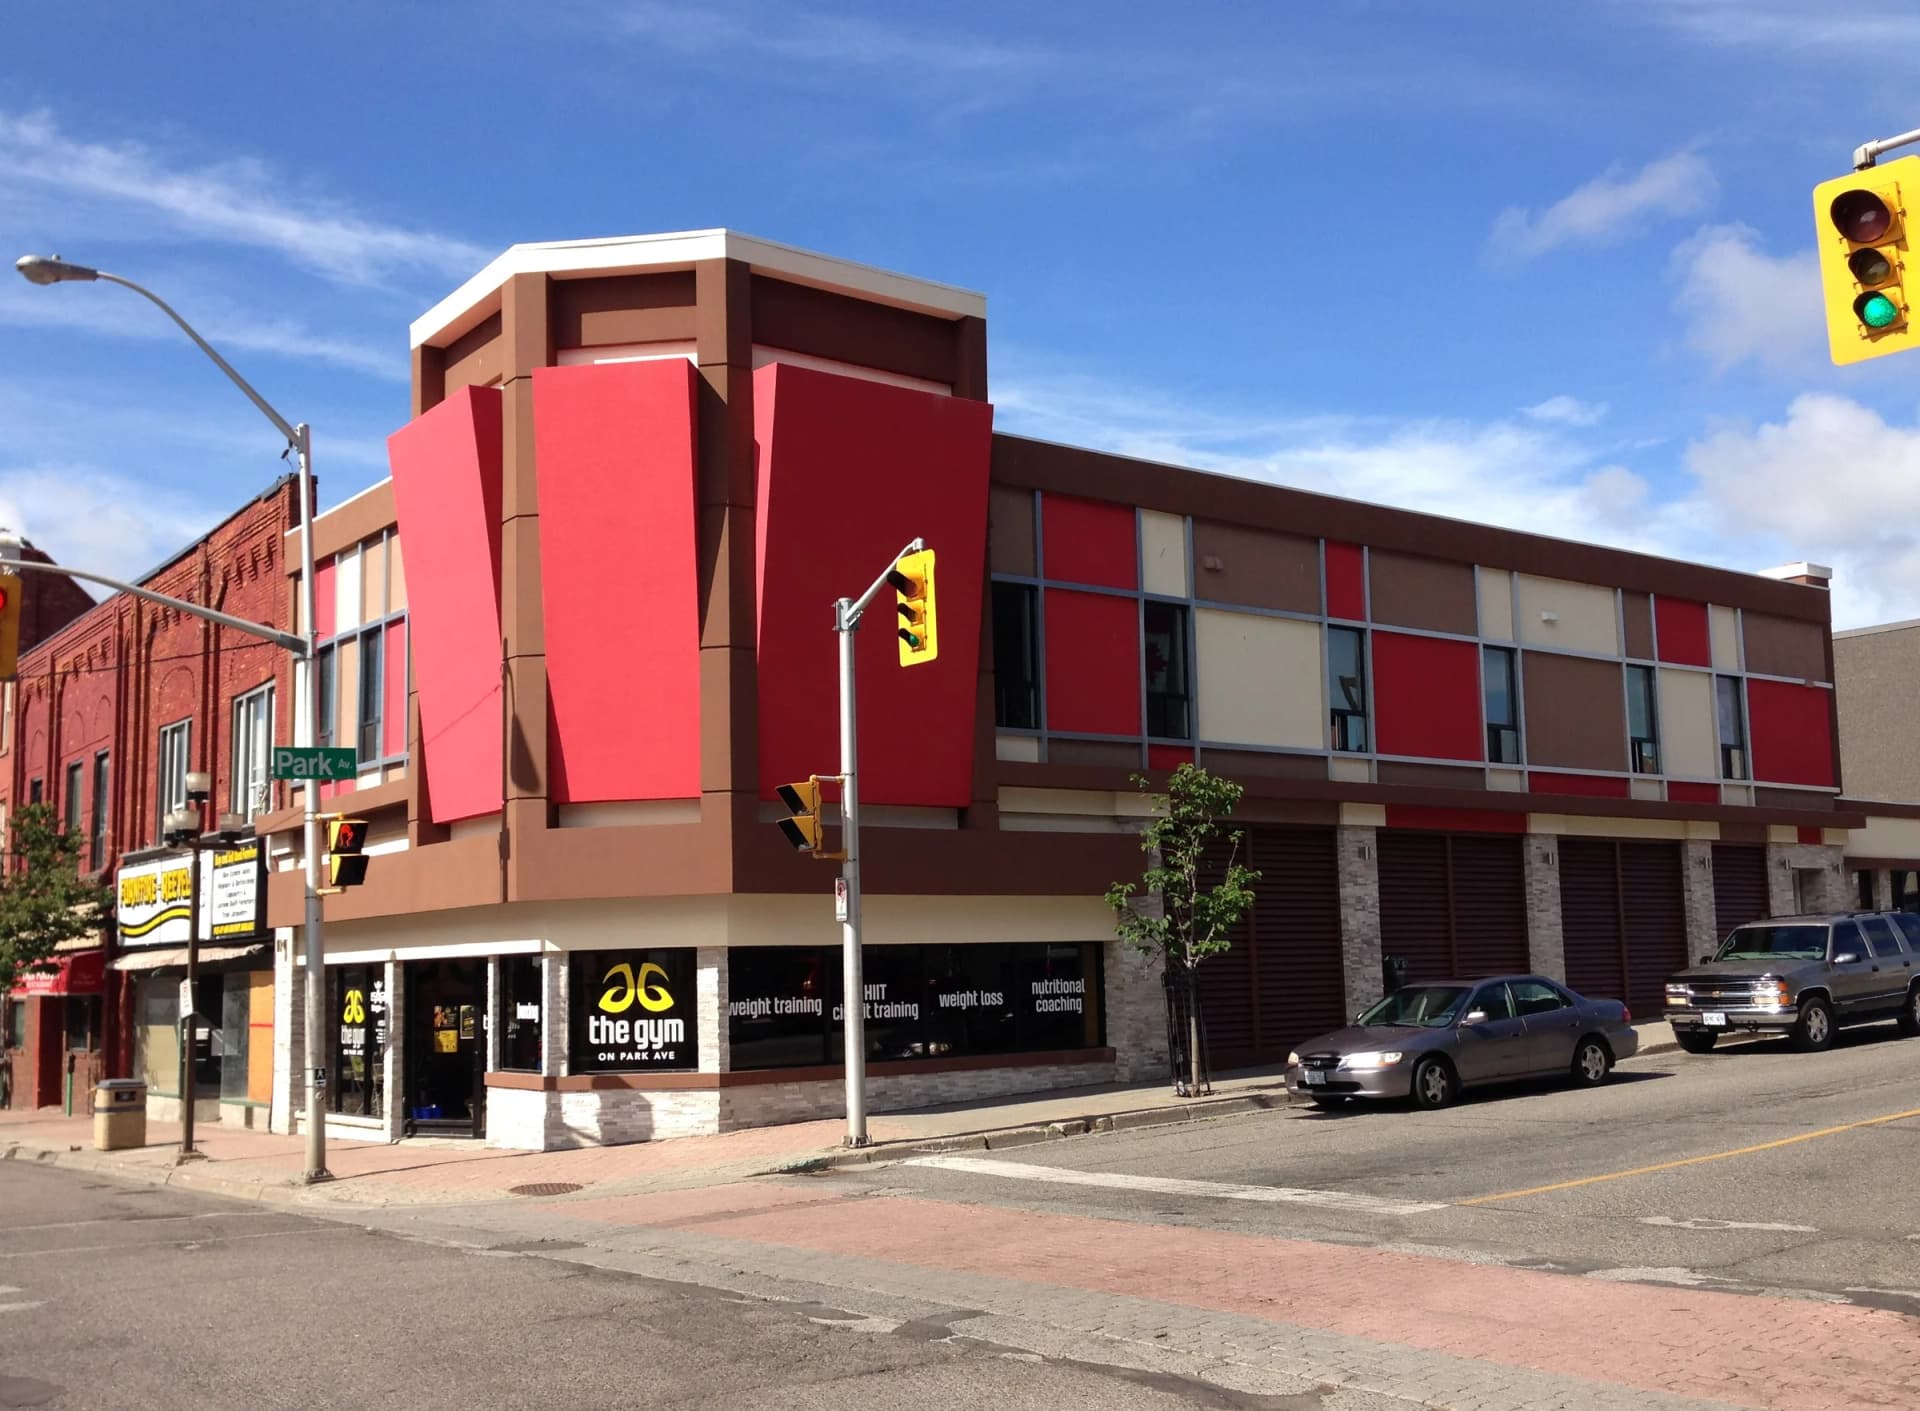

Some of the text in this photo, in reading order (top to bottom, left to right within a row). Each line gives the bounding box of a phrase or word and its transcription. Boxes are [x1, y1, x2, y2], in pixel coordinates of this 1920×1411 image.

[276, 751, 353, 776] Park Av.
[864, 984, 887, 1001] HIIT
[1031, 978, 1085, 995] nutritional
[729, 996, 822, 1019] weight training
[939, 990, 1004, 1010] weight loss
[1035, 996, 1082, 1014] coaching
[874, 1001, 919, 1020] training
[589, 1015, 684, 1050] the gym
[598, 1050, 675, 1061] ON PARK AVE
